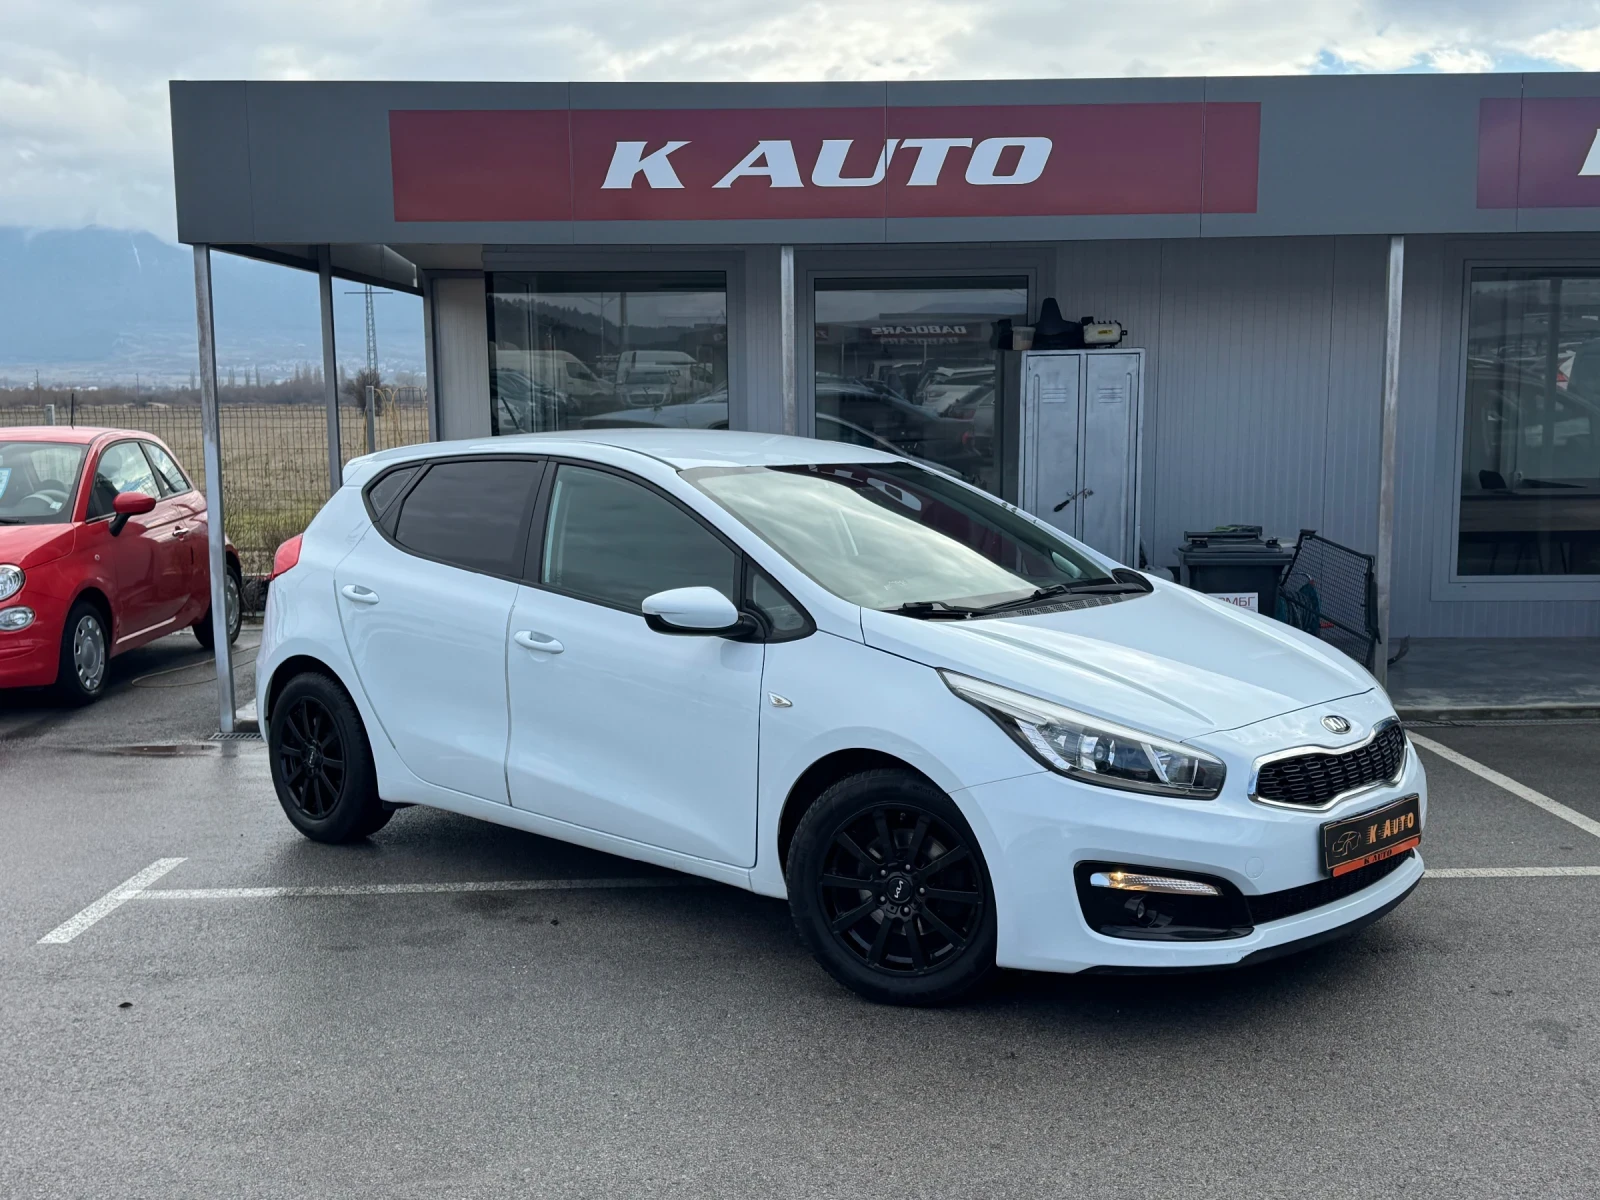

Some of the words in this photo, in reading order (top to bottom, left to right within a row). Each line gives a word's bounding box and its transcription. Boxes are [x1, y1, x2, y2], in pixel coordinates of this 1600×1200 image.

[600, 139, 693, 189] K
[711, 135, 1054, 189] AUTO
[1367, 823, 1378, 844] K
[1382, 812, 1414, 839] AUTO
